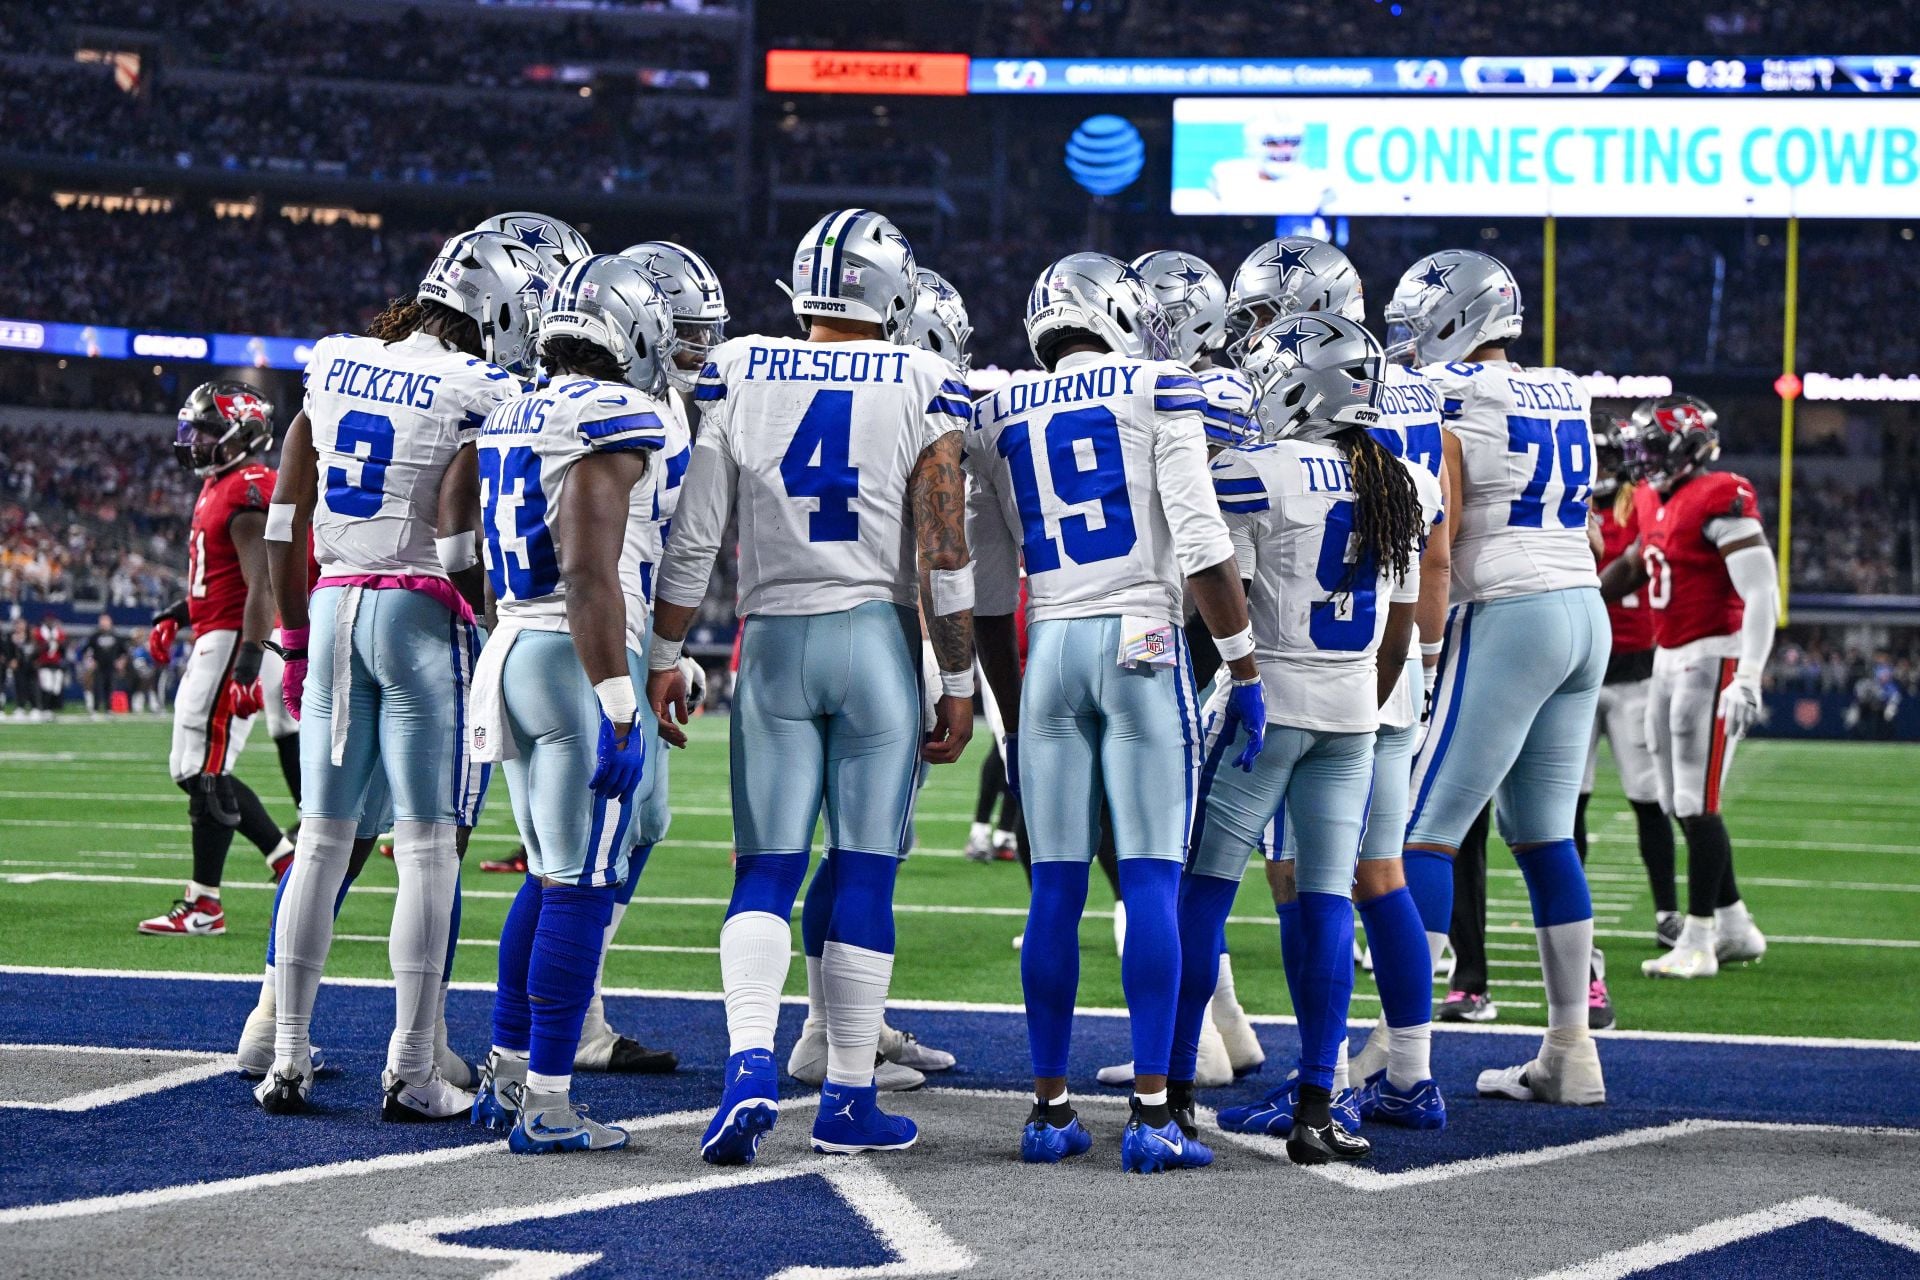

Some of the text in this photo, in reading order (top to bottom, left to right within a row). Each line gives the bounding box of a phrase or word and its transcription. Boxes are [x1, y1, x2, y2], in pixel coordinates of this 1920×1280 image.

[1344, 126, 1723, 184] CONNECTING
[546, 314, 579, 324] COWBOYS
[803, 300, 846, 312] COWBOYS
[325, 358, 442, 410] PICKENS
[744, 346, 910, 384] PRESCOTT
[973, 365, 1142, 431] FLOURNOY
[1508, 378, 1583, 412] STEELE
[324, 409, 396, 519] 3
[780, 388, 859, 543] 4
[996, 404, 1138, 576] 19
[1506, 414, 1593, 529] 78
[478, 445, 561, 601] 33
[1309, 500, 1379, 651] 9
